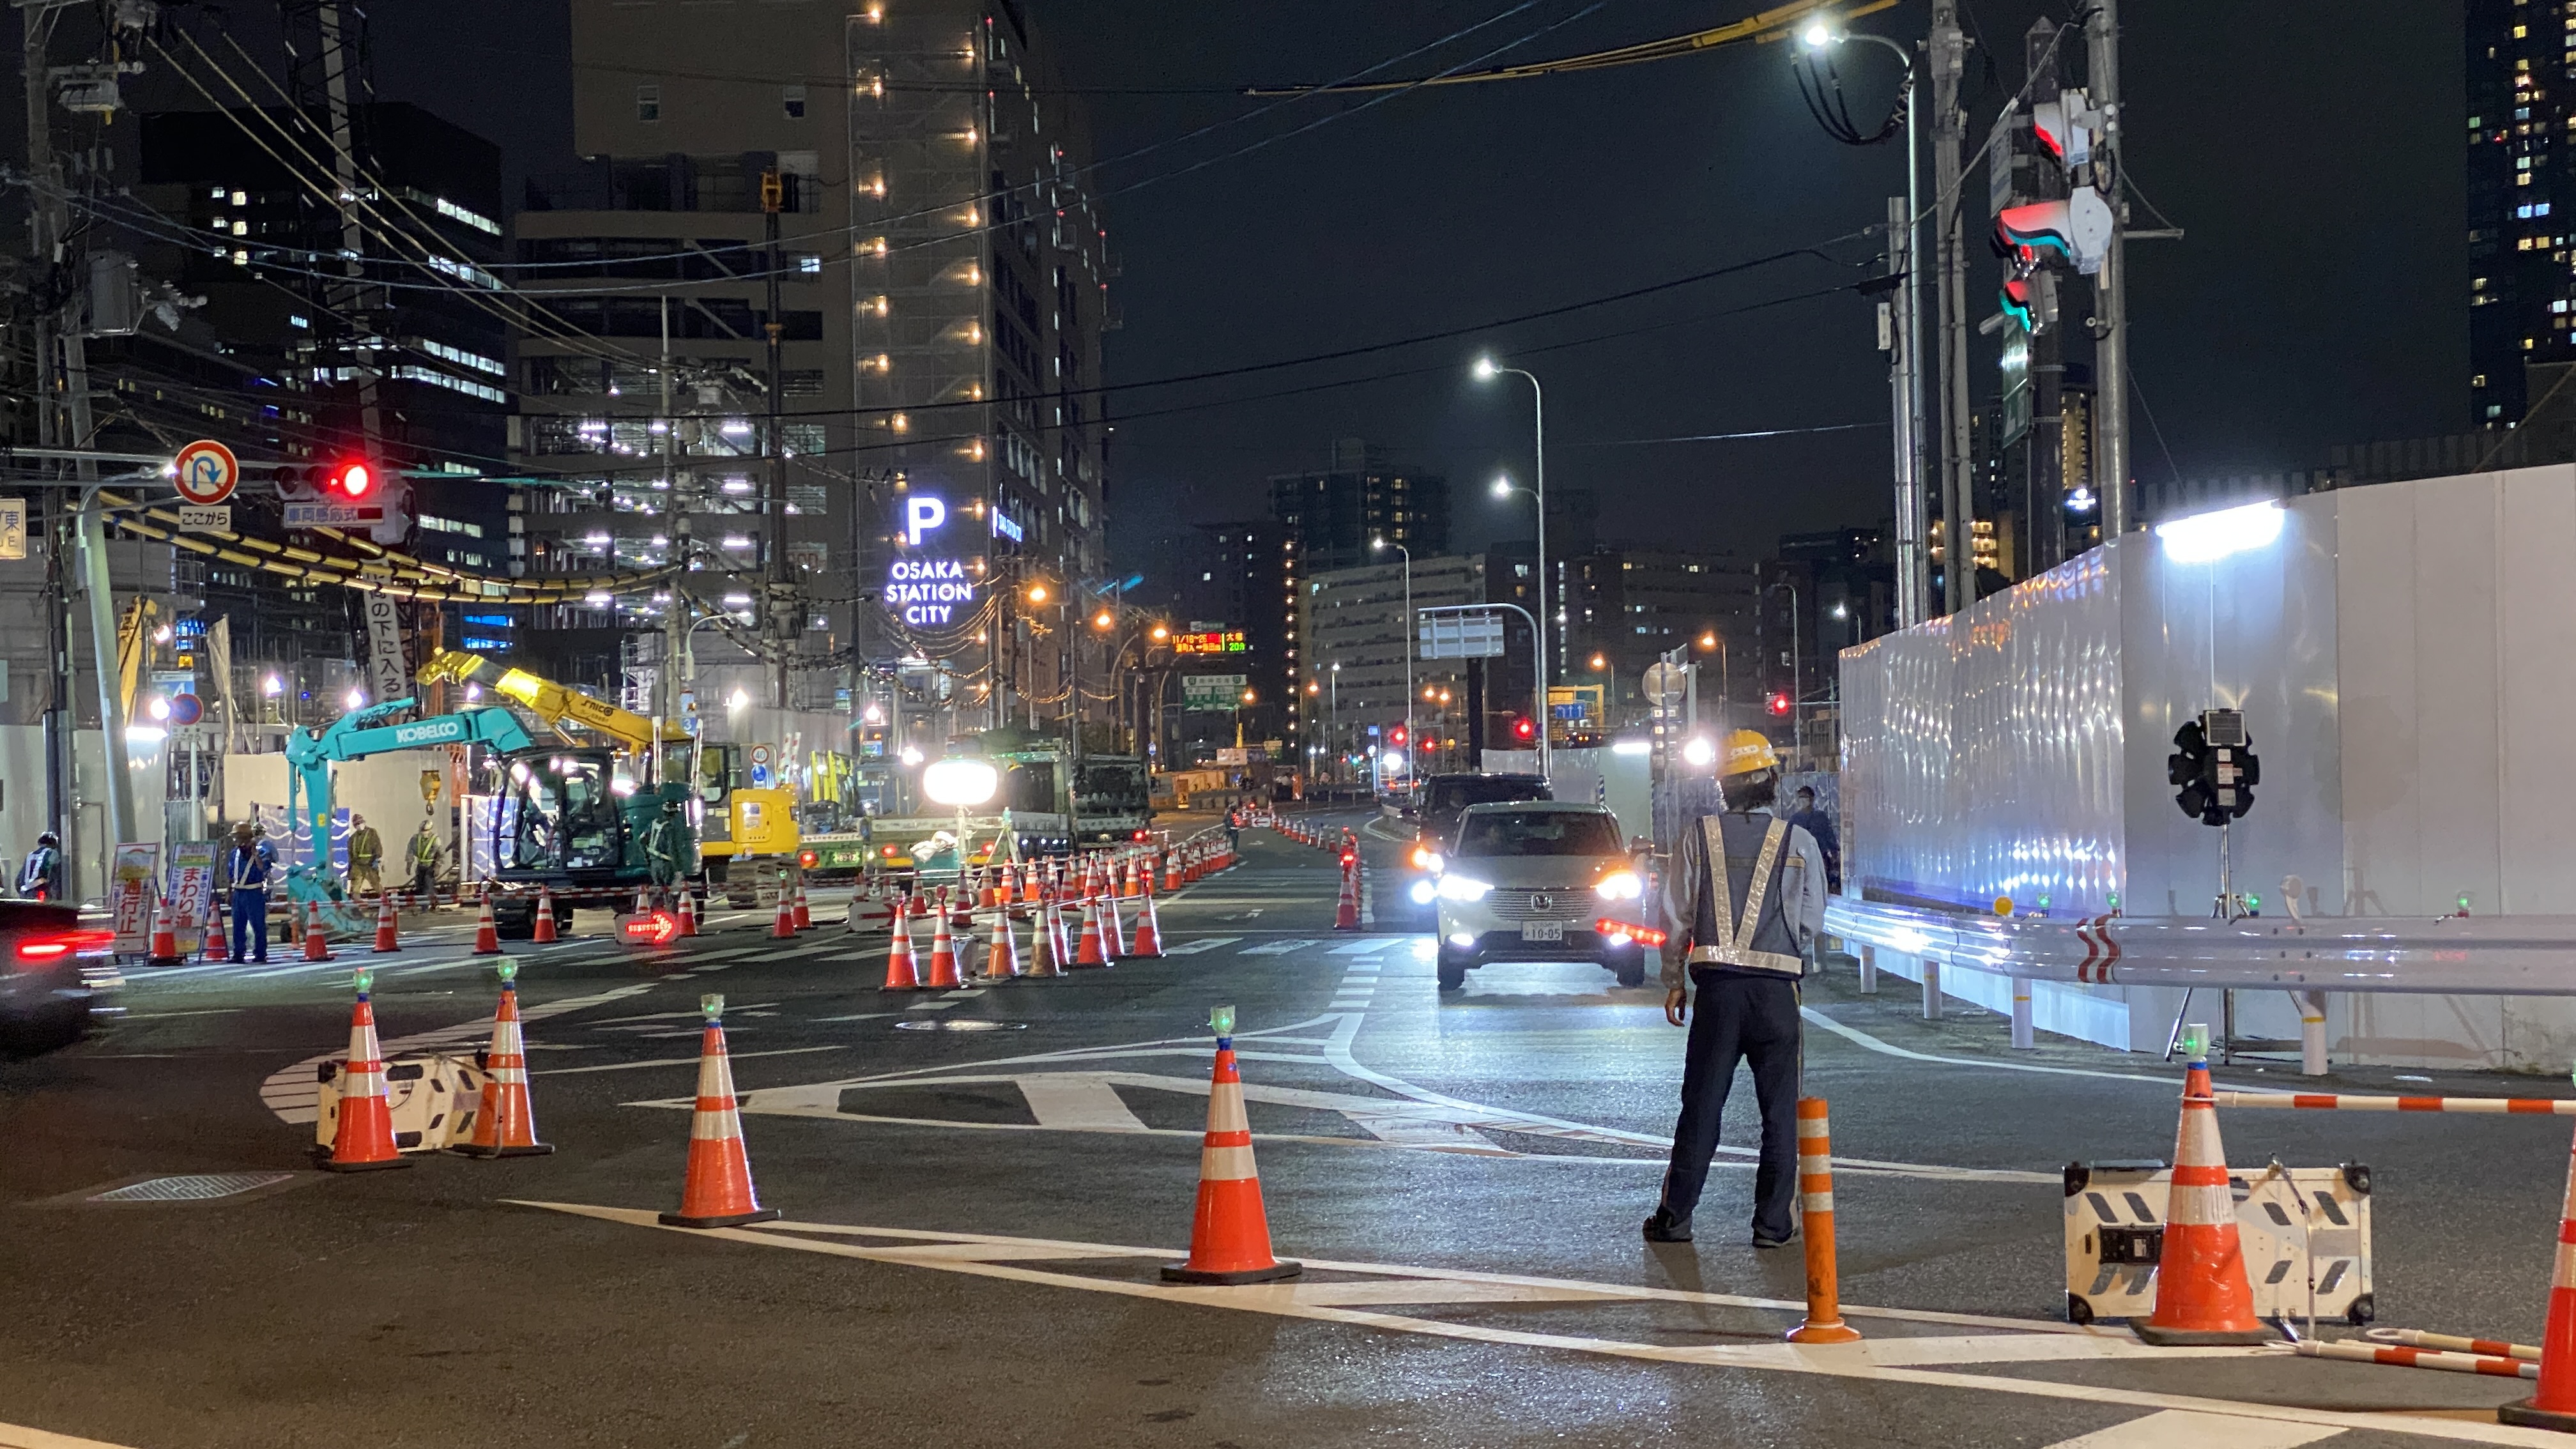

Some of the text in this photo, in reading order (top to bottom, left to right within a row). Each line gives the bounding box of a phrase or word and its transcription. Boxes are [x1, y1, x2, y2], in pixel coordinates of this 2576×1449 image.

[182, 512, 227, 525] ここから
[288, 507, 356, 522] 車両感応式
[908, 497, 945, 545] P
[891, 561, 963, 579] OSAKA
[886, 583, 972, 602] STATION
[906, 606, 951, 624] CITY
[395, 722, 458, 743] KOBELCO
[684, 718, 692, 731] 3
[755, 750, 766, 760] 40
[872, 745, 878, 754] 2
[118, 877, 142, 934] 通行止
[176, 866, 201, 928] まわり道
[1533, 928, 1560, 939] 10-05
